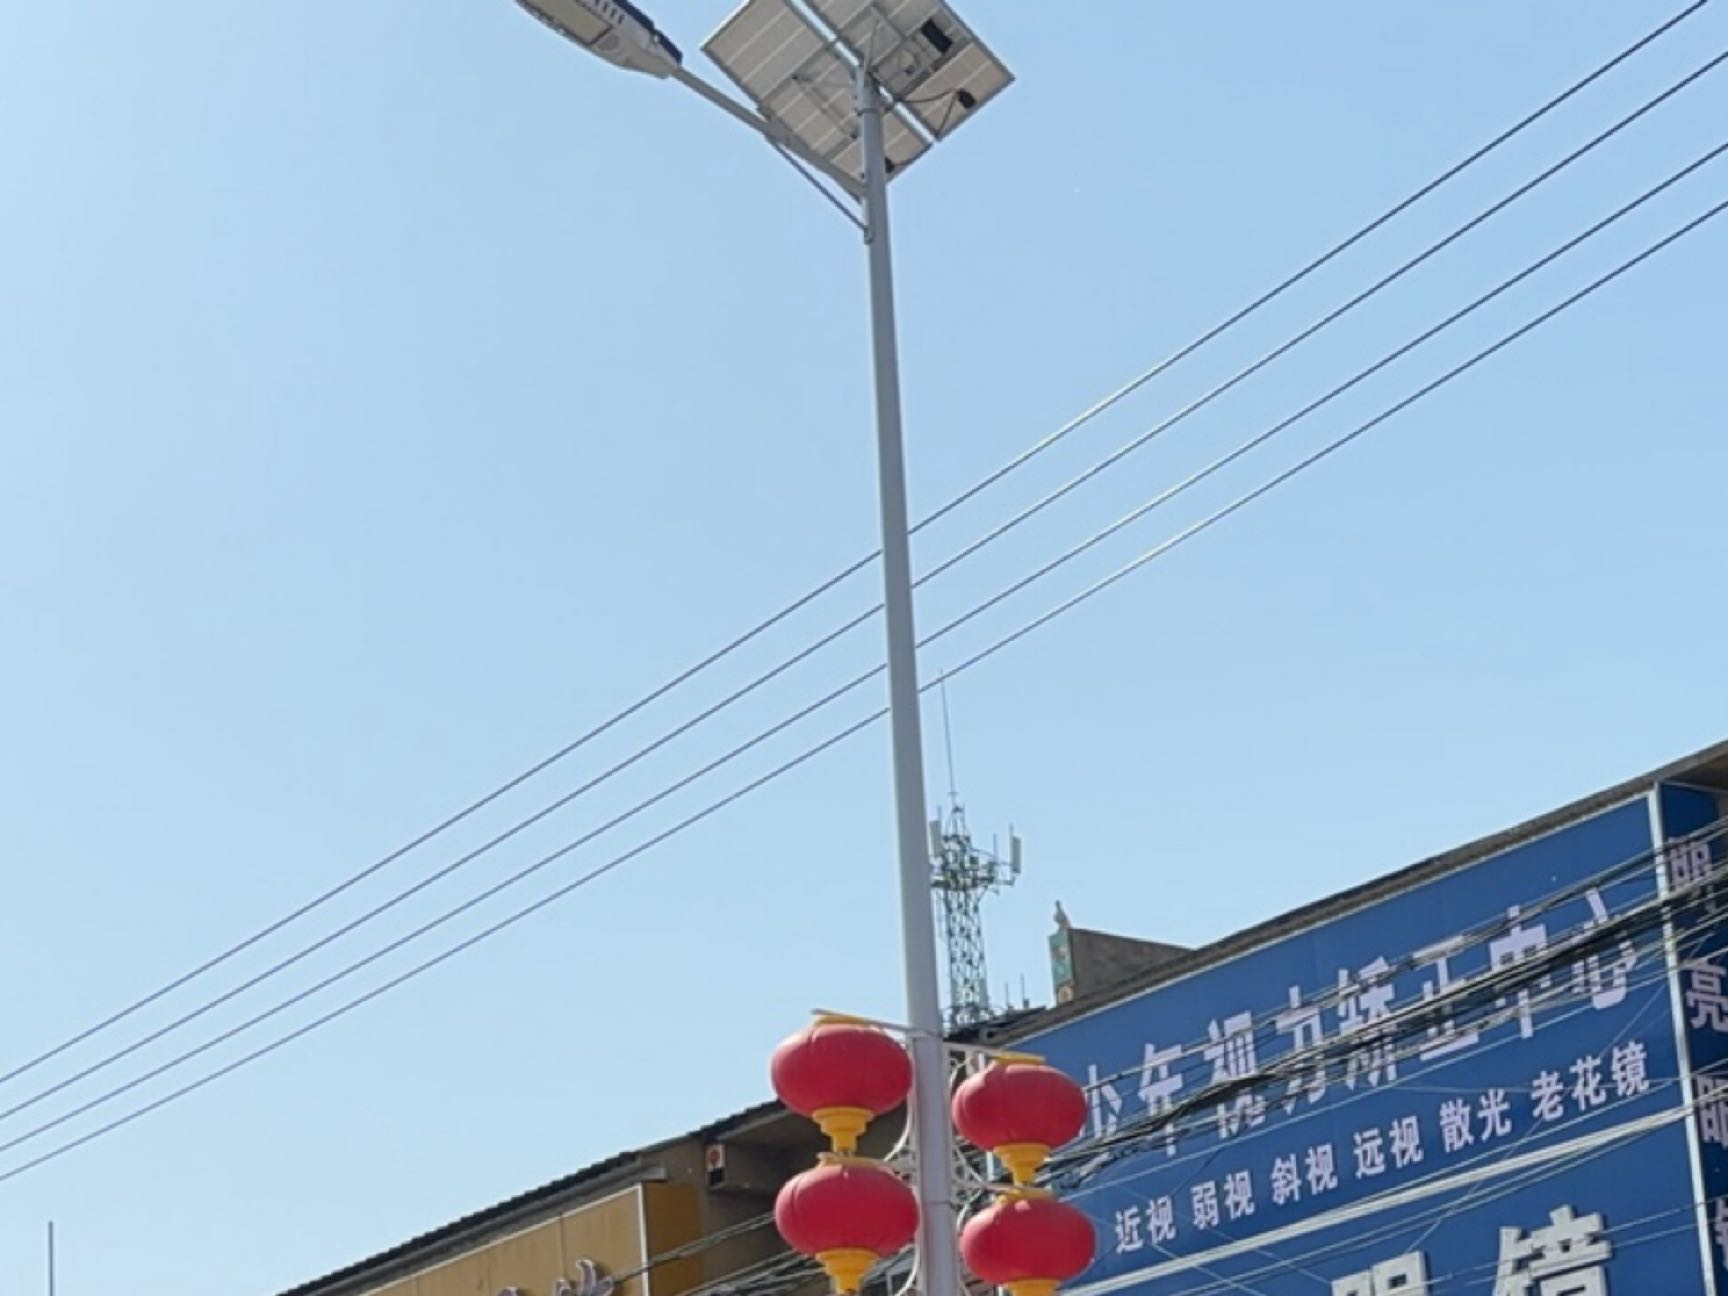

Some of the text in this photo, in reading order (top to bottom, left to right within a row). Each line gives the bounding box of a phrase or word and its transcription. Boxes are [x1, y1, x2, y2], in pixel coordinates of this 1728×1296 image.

[1115, 1040, 1651, 1254] 近视 弱视 斜视 远视 散光 老花镜
